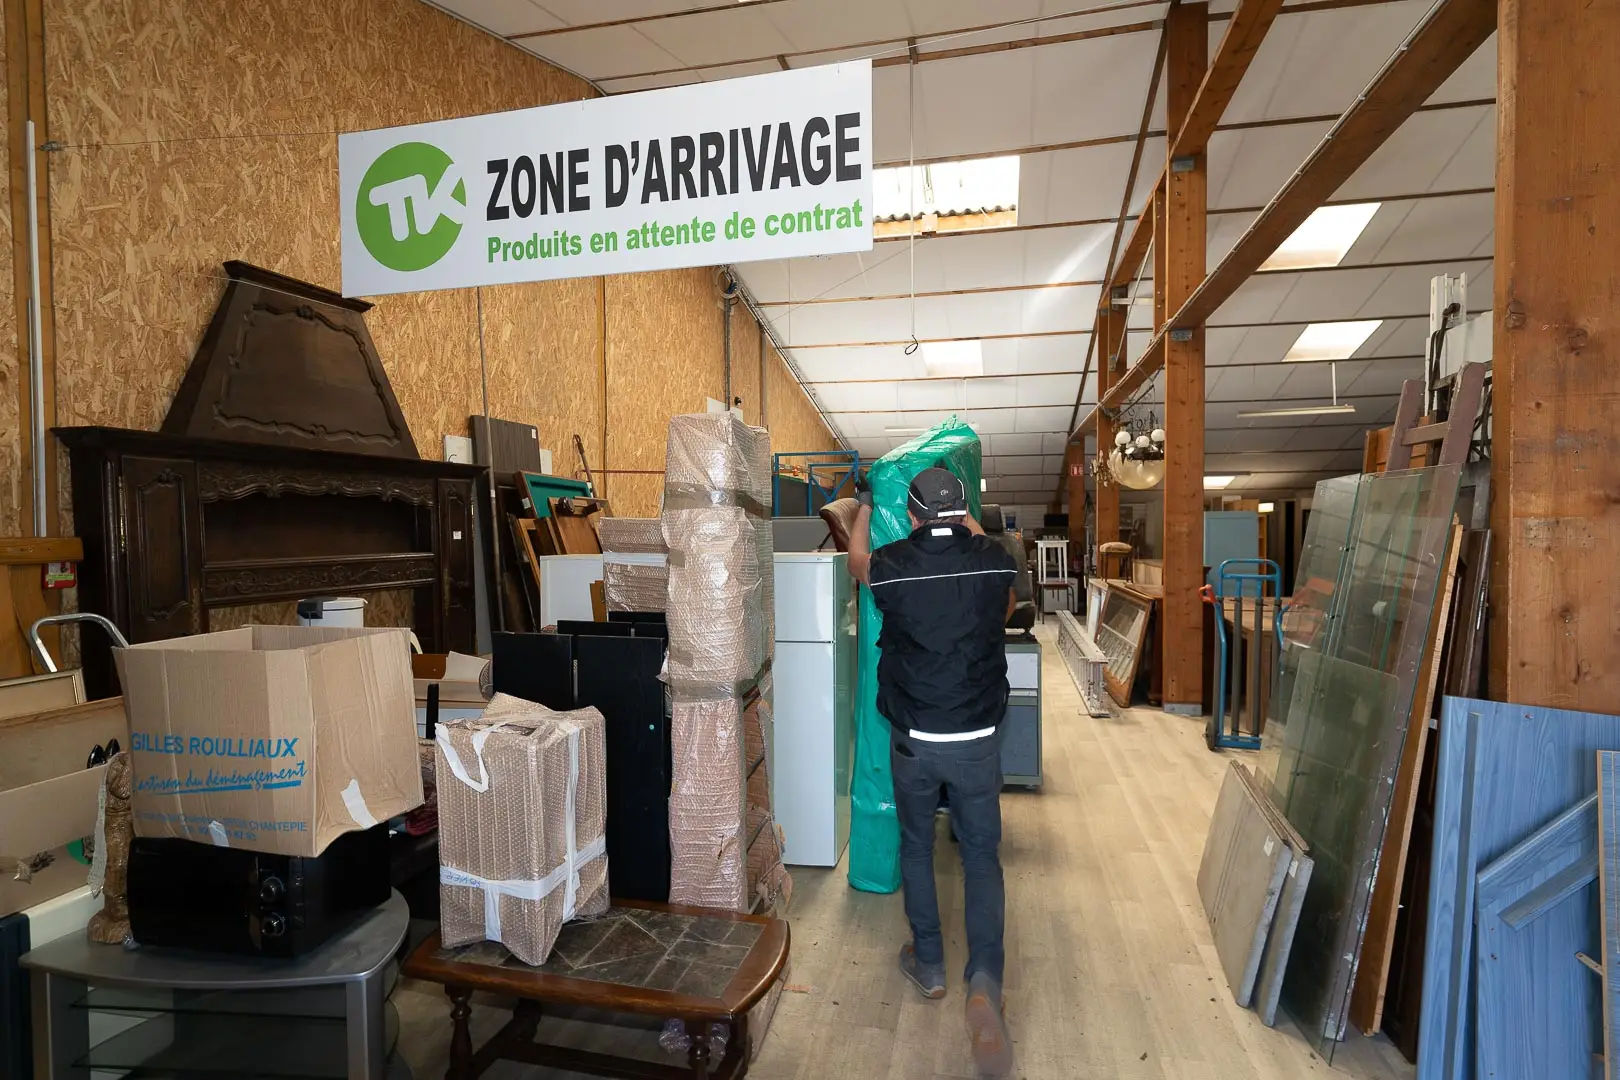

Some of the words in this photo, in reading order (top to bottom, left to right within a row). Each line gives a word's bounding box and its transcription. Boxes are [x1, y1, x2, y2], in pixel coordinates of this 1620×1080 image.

[486, 148, 591, 221] ZONE
[604, 111, 862, 208] D'ARRIVAGE
[487, 230, 583, 263] Produits
[589, 231, 619, 253] en
[626, 217, 717, 250] attente
[724, 211, 757, 240] de
[764, 199, 863, 236] contrat
[131, 731, 185, 755] GILLES
[188, 736, 299, 759] ROULLIAUX
[184, 768, 203, 787] du
[205, 759, 308, 791] déménagement
[248, 820, 308, 832] CHANTEPIE
